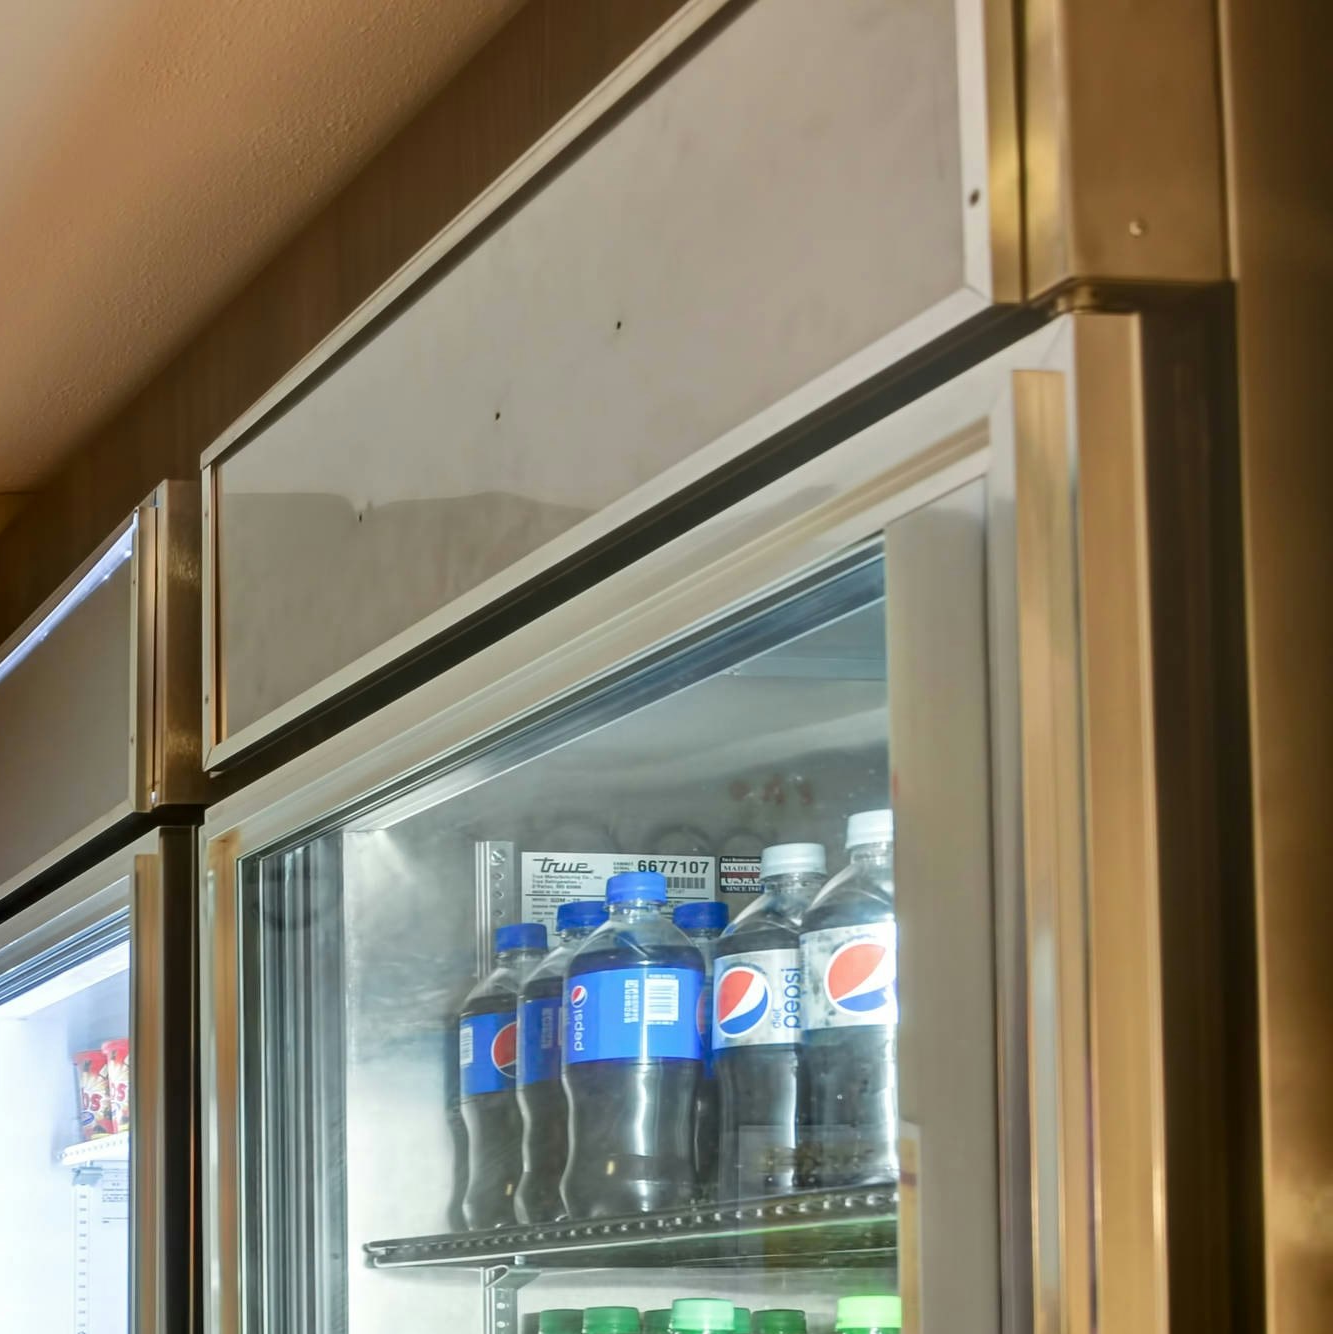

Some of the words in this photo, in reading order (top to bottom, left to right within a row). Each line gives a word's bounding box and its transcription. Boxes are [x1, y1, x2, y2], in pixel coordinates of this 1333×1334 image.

[637, 859, 710, 875] 6677107
[781, 968, 801, 1029] pepsi
[573, 1009, 585, 1052] pepsi
